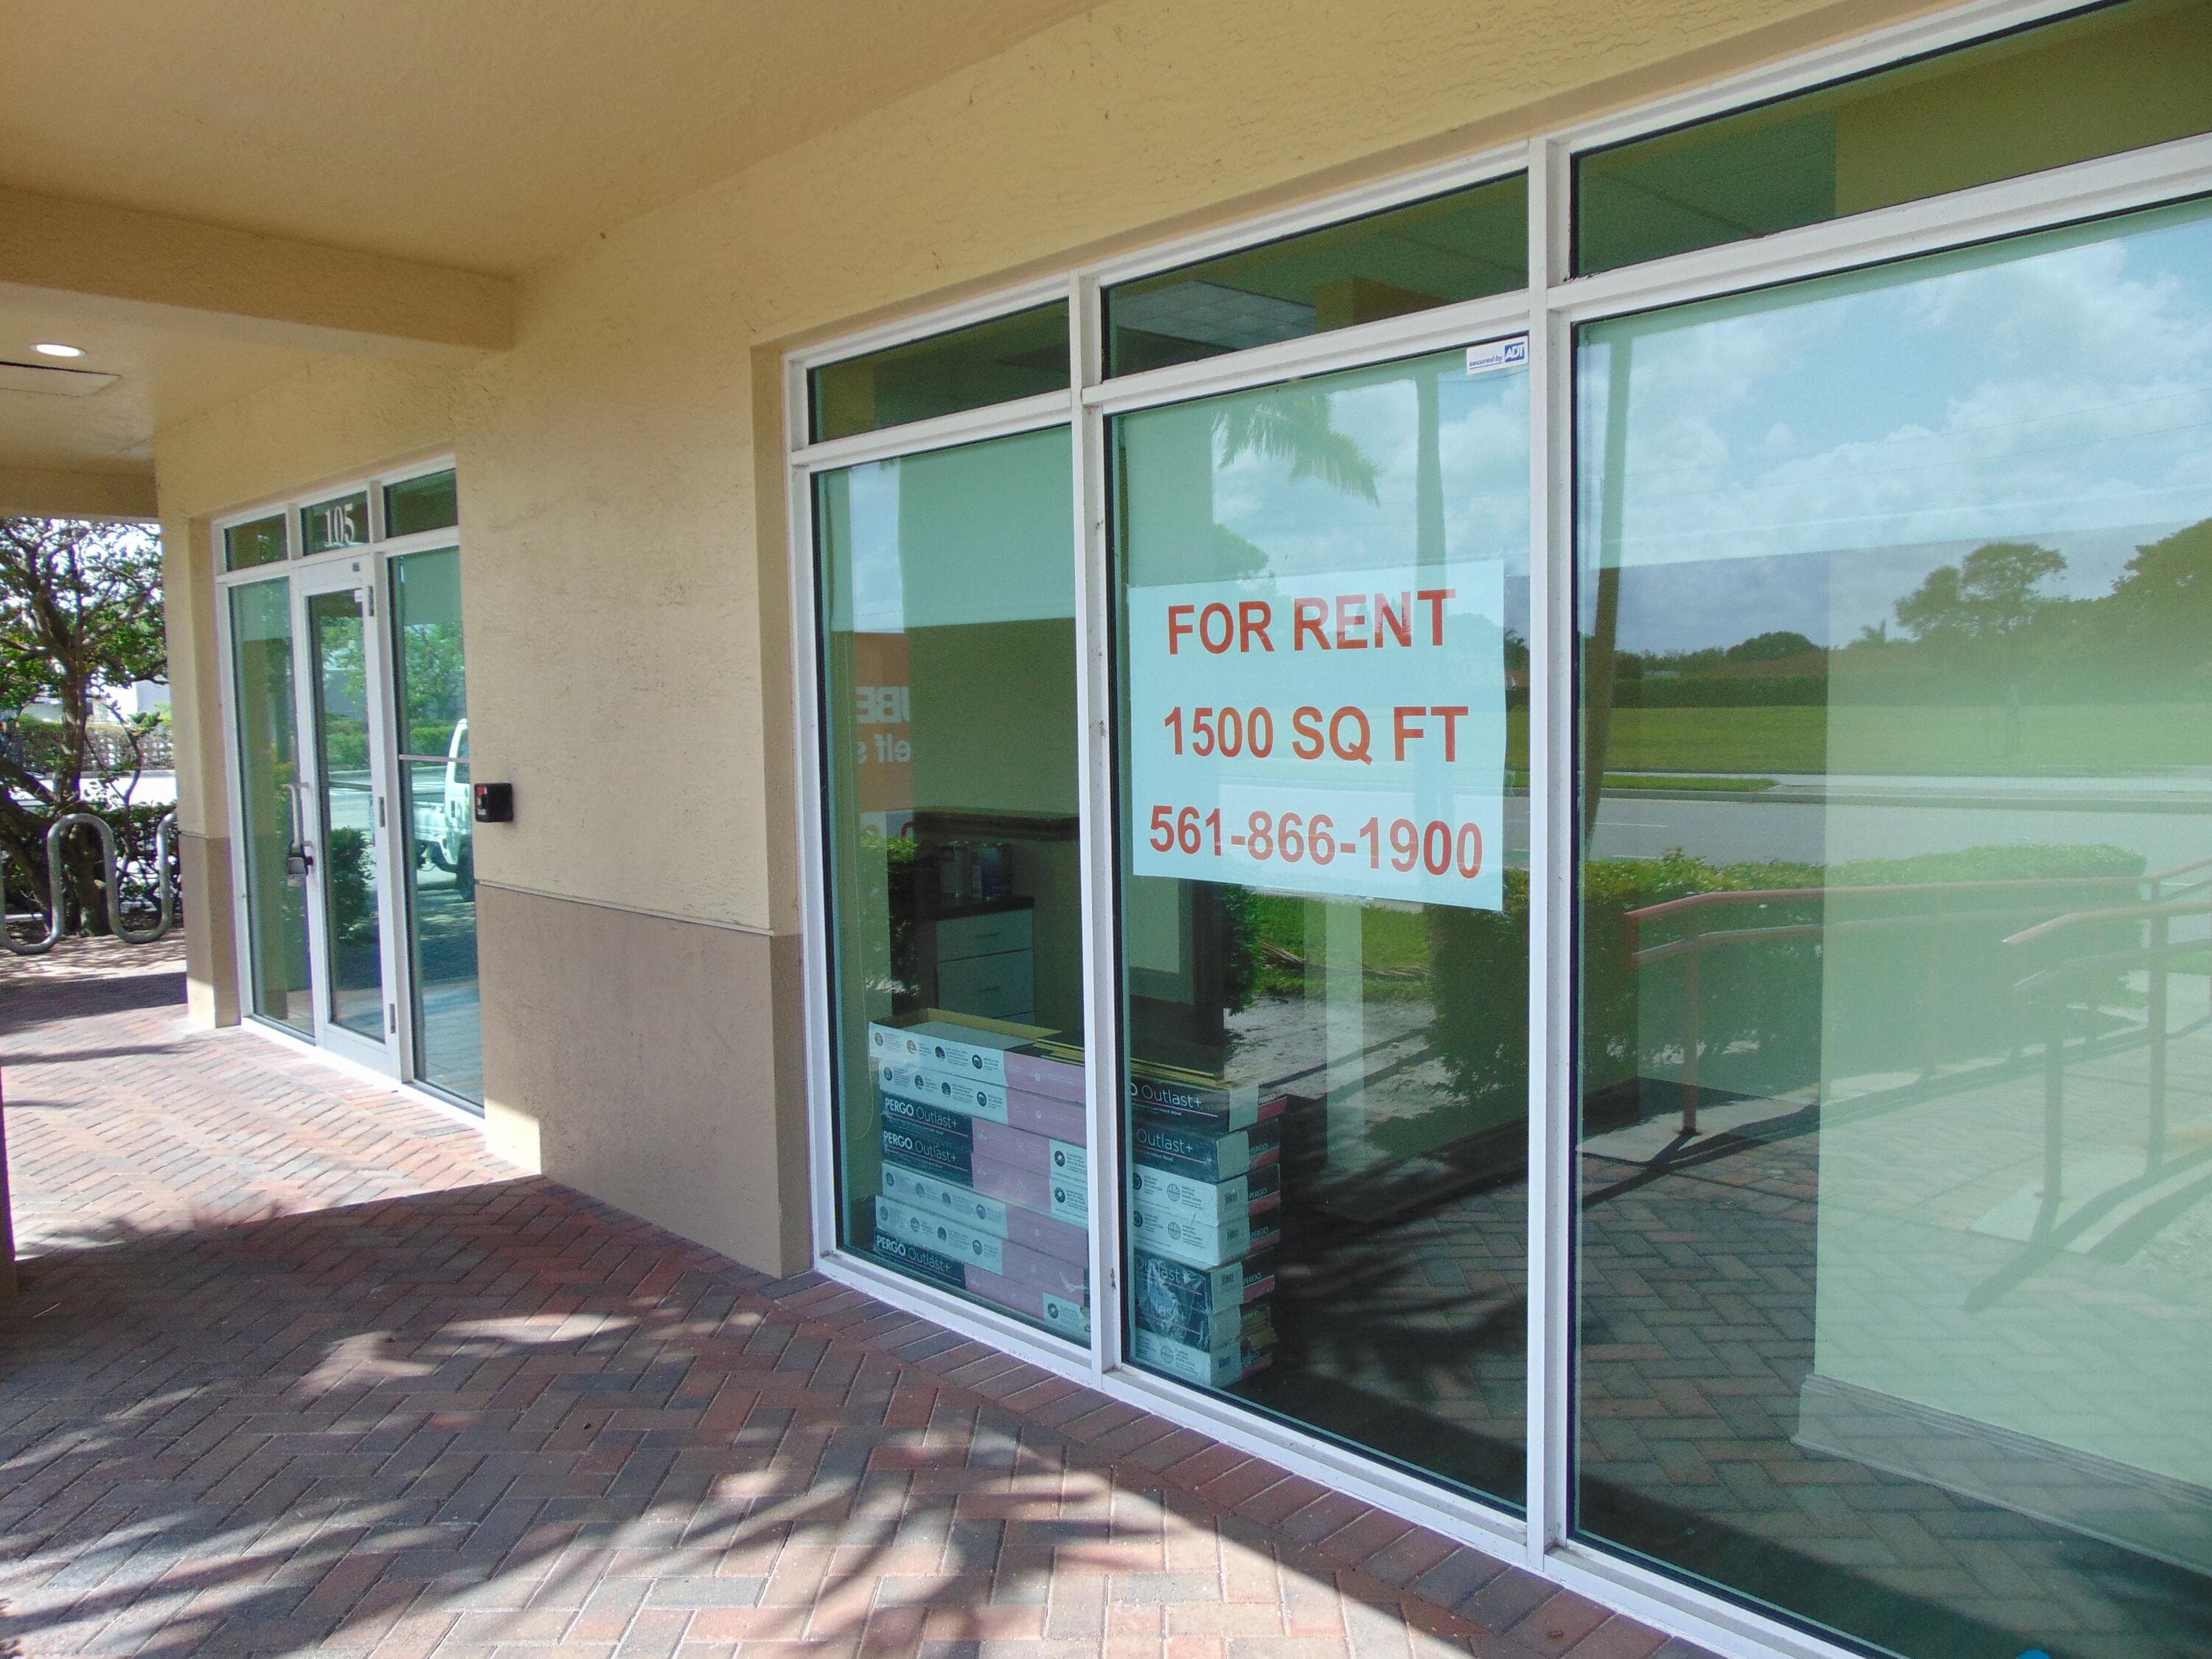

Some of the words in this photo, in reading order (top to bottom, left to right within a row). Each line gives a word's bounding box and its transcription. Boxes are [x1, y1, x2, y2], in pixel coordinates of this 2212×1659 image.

[1469, 355, 1495, 366] secured
[1495, 353, 1503, 363] by
[1505, 344, 1524, 360] ADT
[324, 503, 355, 547] 105
[1168, 600, 1275, 655] FOR
[1293, 588, 1456, 651] RENT
[1164, 706, 1273, 757] 1500
[1292, 706, 1373, 765] SQ
[1394, 706, 1469, 762] FT
[1150, 804, 1483, 878] 561-866-1900
[885, 1097, 914, 1116] PERGO
[916, 1106, 958, 1128] Outlast+
[1141, 1085, 1203, 1108] Outlast+
[883, 1130, 913, 1150] PERGO
[915, 1141, 956, 1162] Outlast+
[1136, 1128, 1193, 1153] Outlast+
[877, 1234, 906, 1256] PERGO
[908, 1247, 950, 1272] Outlast+
